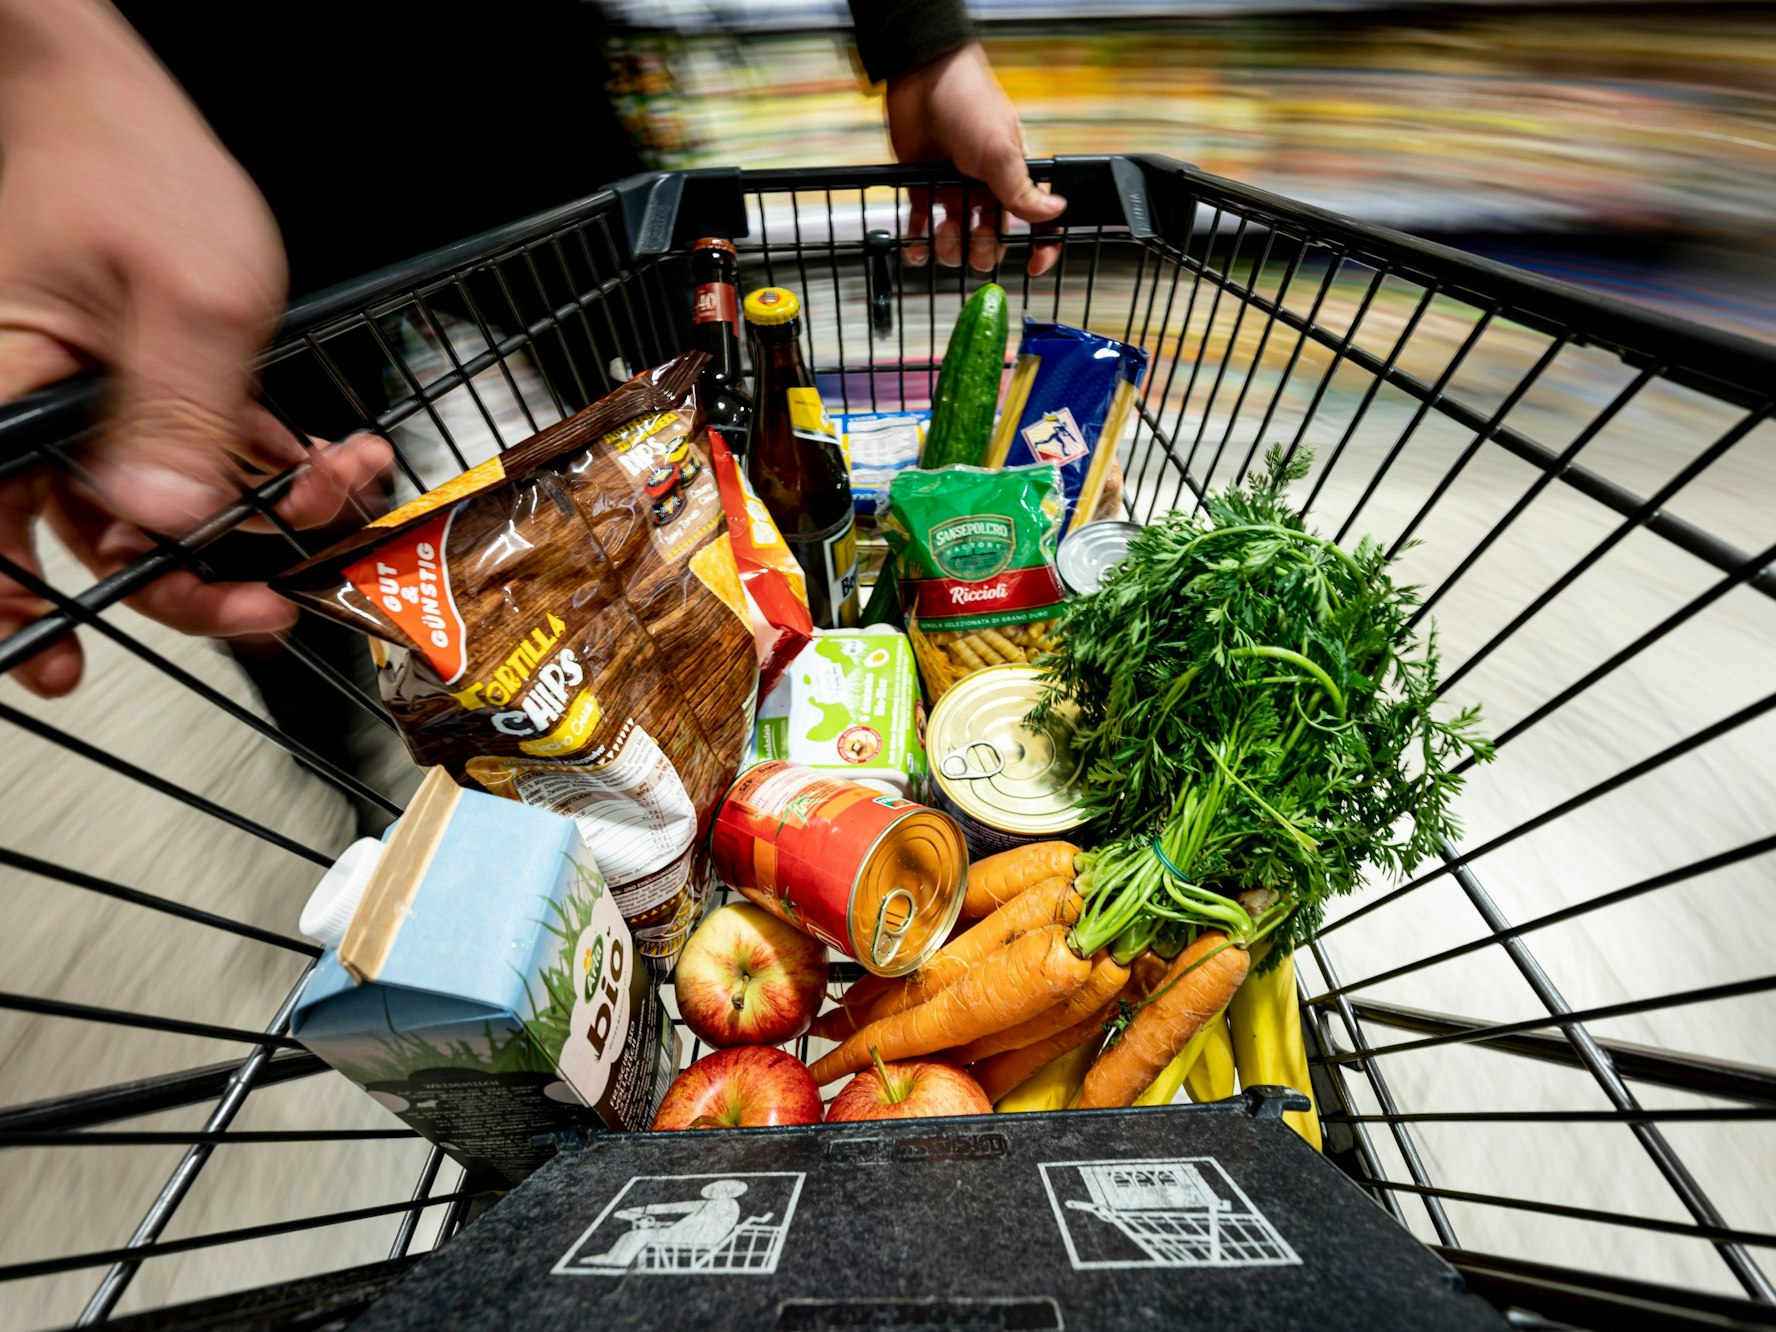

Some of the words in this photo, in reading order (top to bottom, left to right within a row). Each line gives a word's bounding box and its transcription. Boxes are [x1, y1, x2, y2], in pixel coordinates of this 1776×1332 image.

[936, 522, 1008, 546] SANSEPOLCRO
[376, 561, 403, 612] GUT
[400, 585, 419, 604] &
[416, 542, 449, 648] GÜNSTIG
[950, 583, 1009, 605] Riccioli
[944, 617, 990, 629] SELEZIONATA
[1001, 614, 1028, 623] GRANO
[1029, 611, 1049, 619] DURO
[448, 612, 566, 711] TORTILLA
[491, 648, 583, 736] CHIPS
[587, 946, 603, 995] Arla
[587, 939, 623, 1063] bio
